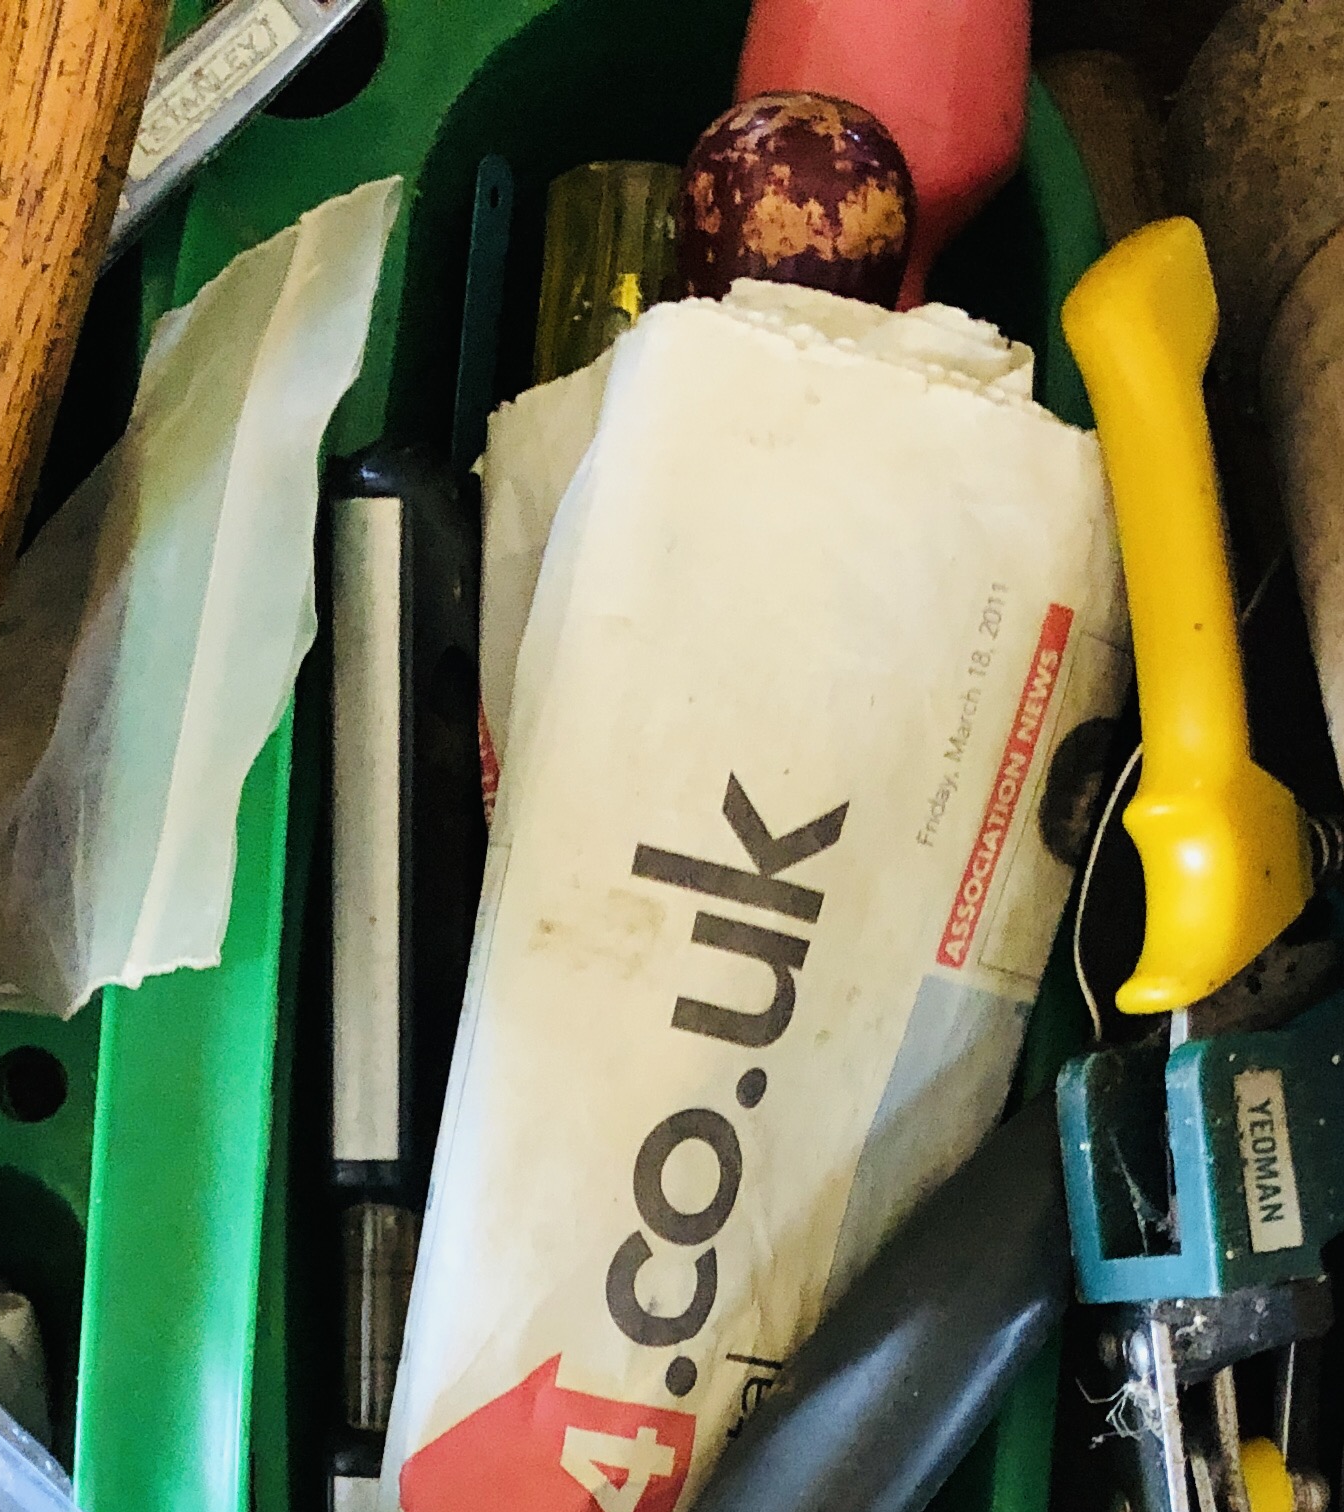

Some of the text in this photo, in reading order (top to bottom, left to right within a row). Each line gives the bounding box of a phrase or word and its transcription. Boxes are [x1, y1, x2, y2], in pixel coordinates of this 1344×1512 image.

[944, 687, 981, 765] March
[979, 582, 1009, 639] 2011
[943, 650, 1058, 963] ASSOCIATION NEWS
[1246, 1097, 1284, 1224] YEOMAN
